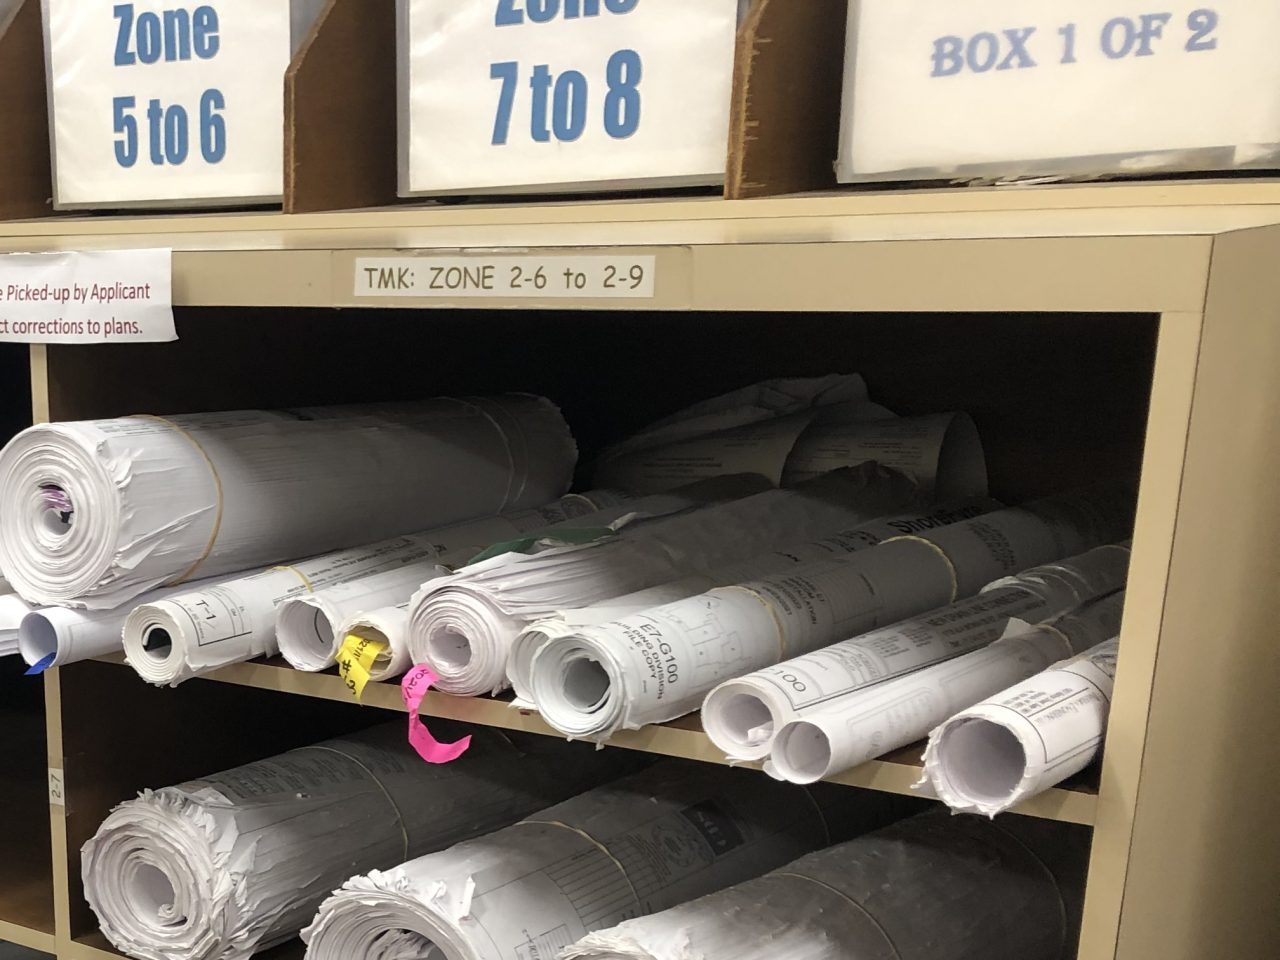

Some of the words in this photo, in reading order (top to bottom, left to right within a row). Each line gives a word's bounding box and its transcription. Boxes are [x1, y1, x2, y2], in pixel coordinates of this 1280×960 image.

[113, 4, 220, 66] Zone
[930, 25, 1038, 78] BOX
[1058, 24, 1080, 64] 1
[1101, 13, 1171, 59] OF
[1184, 9, 1219, 52] 2
[490, 62, 519, 146] 7
[528, 63, 588, 142] to
[603, 49, 641, 140] 8
[113, 96, 138, 168] 5
[147, 98, 189, 165] to
[200, 89, 227, 163] 6
[6, 284, 70, 304] Picked-up
[74, 282, 87, 304] by
[91, 281, 150, 304] Applicant
[364, 266, 415, 289] TMK:
[429, 265, 495, 289] ZONE
[510, 266, 547, 289] 2-6
[563, 268, 586, 289] to
[603, 264, 643, 289] 2-9
[12, 318, 84, 335] corrections
[87, 319, 100, 334] to
[104, 317, 143, 338] plans.
[195, 599, 216, 619] T-1
[640, 623, 678, 684] E7-G100
[50, 774, 62, 799] 2-7
